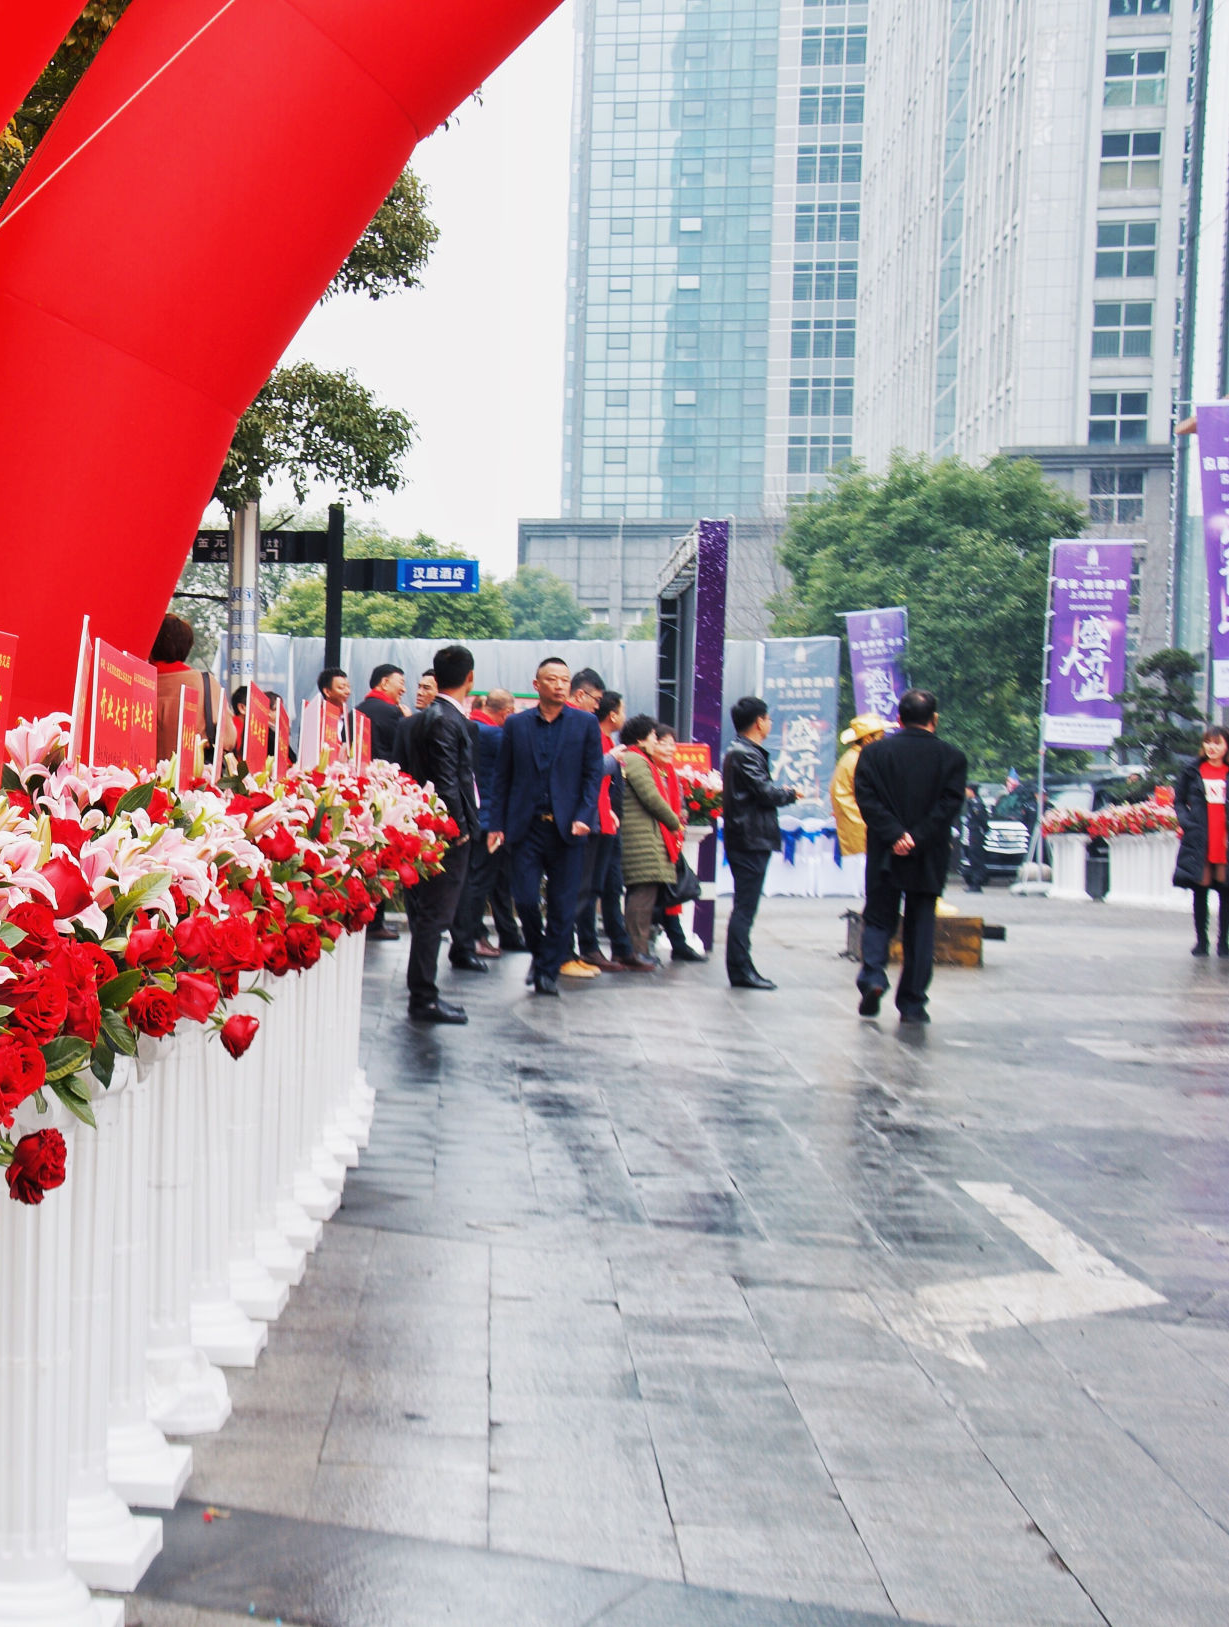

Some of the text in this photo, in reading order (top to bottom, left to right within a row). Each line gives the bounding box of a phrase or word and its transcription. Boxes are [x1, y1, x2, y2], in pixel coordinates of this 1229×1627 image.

[412, 566, 466, 580] 汉庭酒店
[100, 687, 129, 732] 开业大吉
